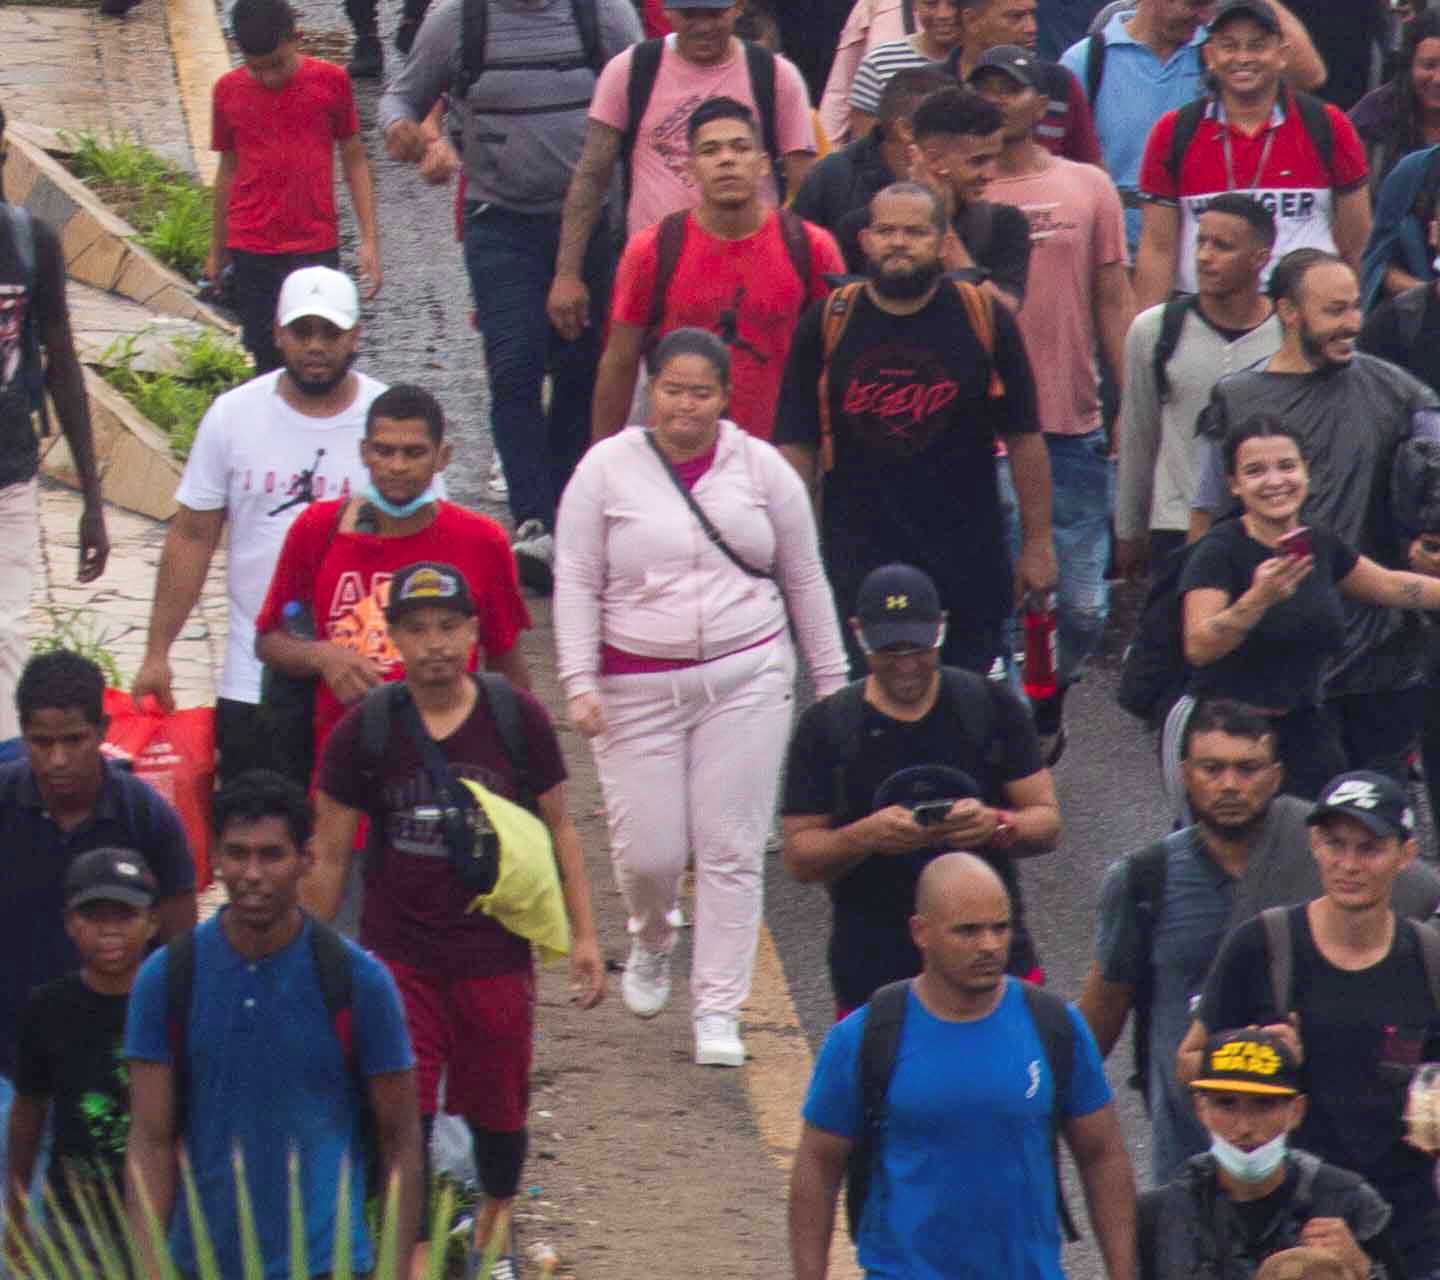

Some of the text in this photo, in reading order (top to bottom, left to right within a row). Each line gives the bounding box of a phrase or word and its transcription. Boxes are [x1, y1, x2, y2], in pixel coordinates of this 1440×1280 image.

[843, 376, 958, 421] LEGEND
[1211, 1041, 1276, 1058] STAR
[1210, 1054, 1281, 1075] WARS
